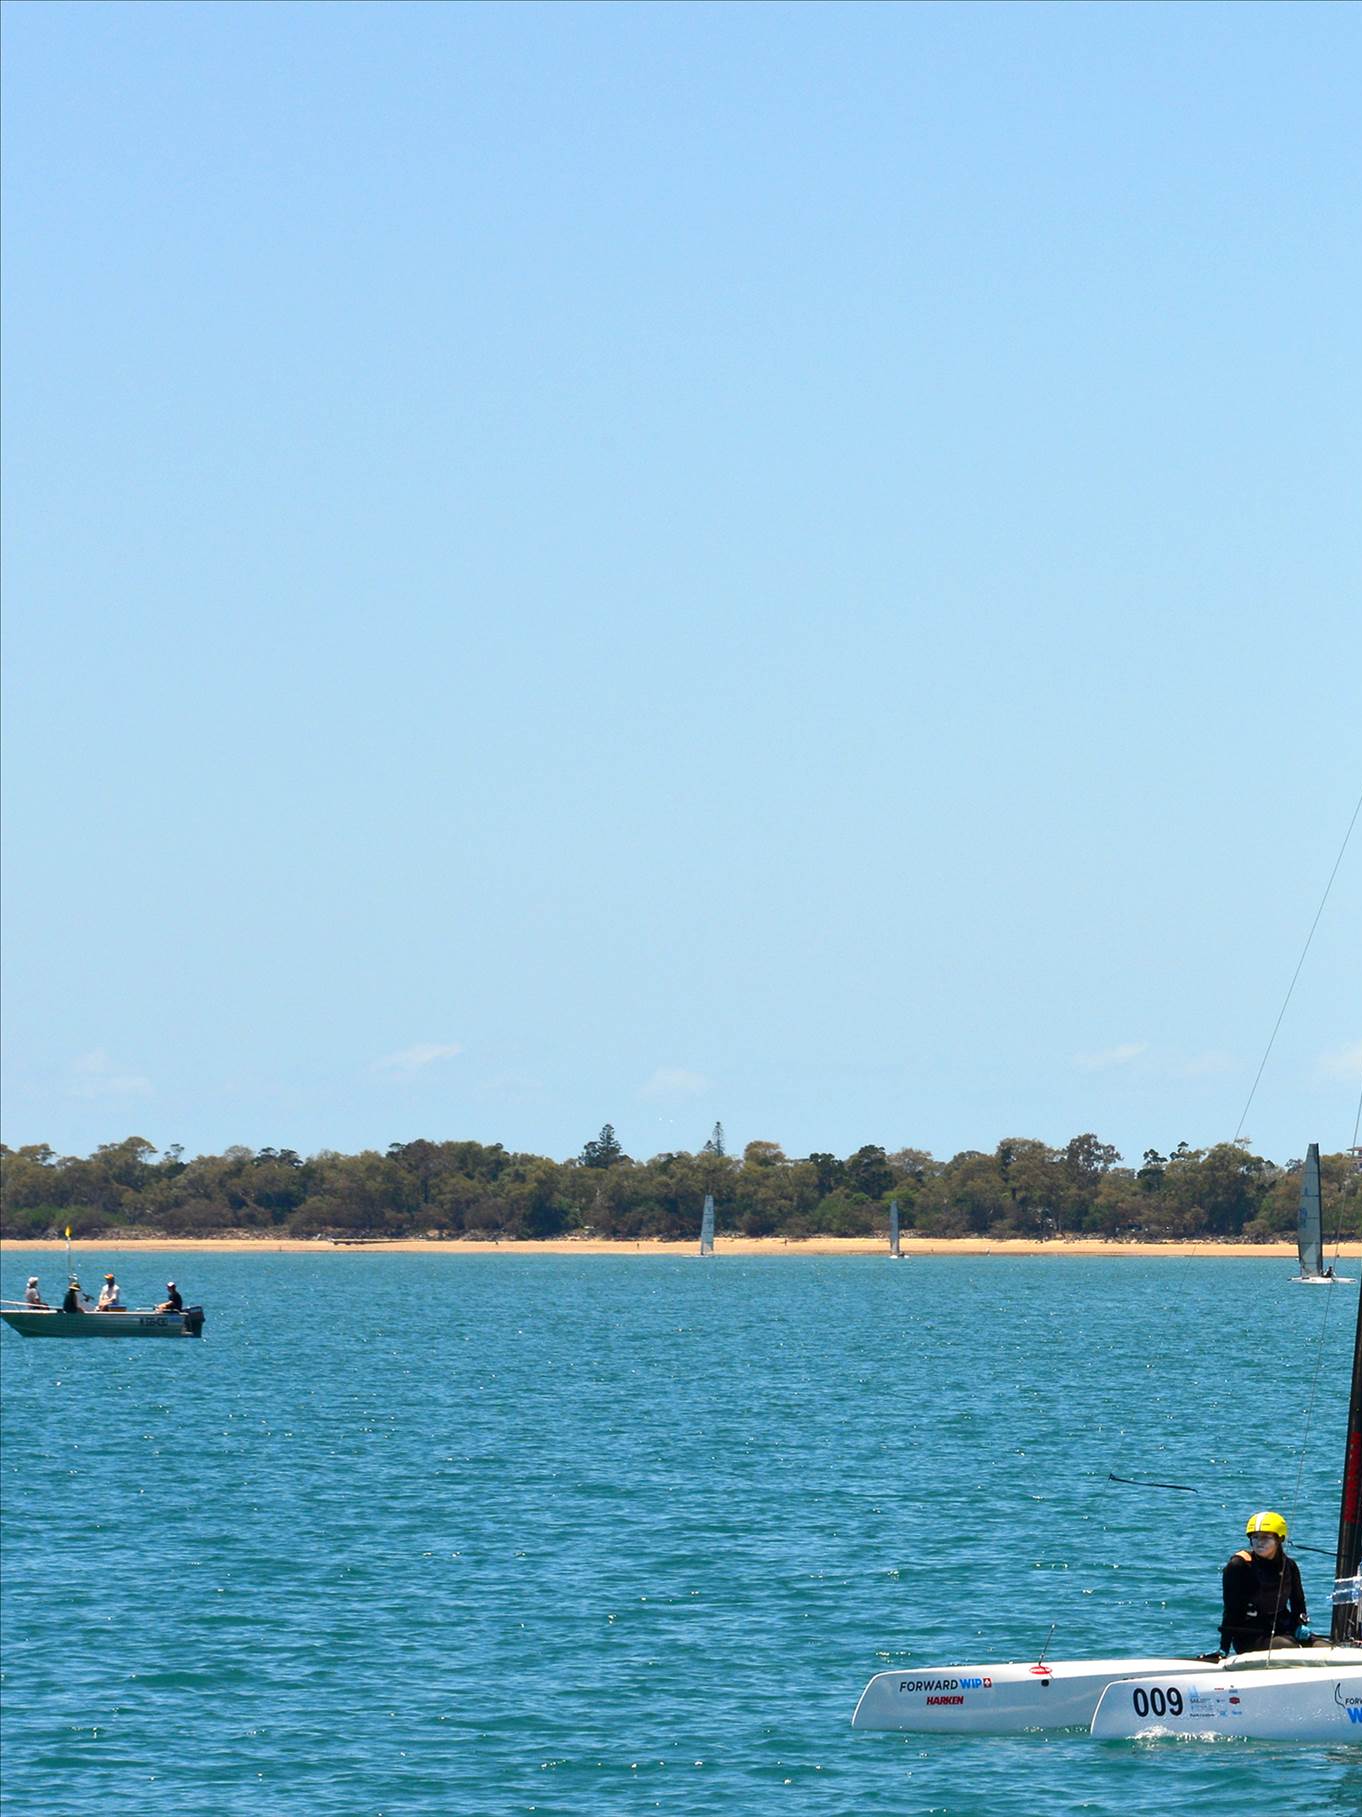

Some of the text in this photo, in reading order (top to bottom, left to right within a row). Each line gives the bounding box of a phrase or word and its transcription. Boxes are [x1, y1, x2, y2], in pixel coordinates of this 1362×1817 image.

[899, 1678, 982, 1692] FORWARD WIP
[926, 1696, 964, 1706] HARKEN
[1133, 1687, 1184, 1717] 009
